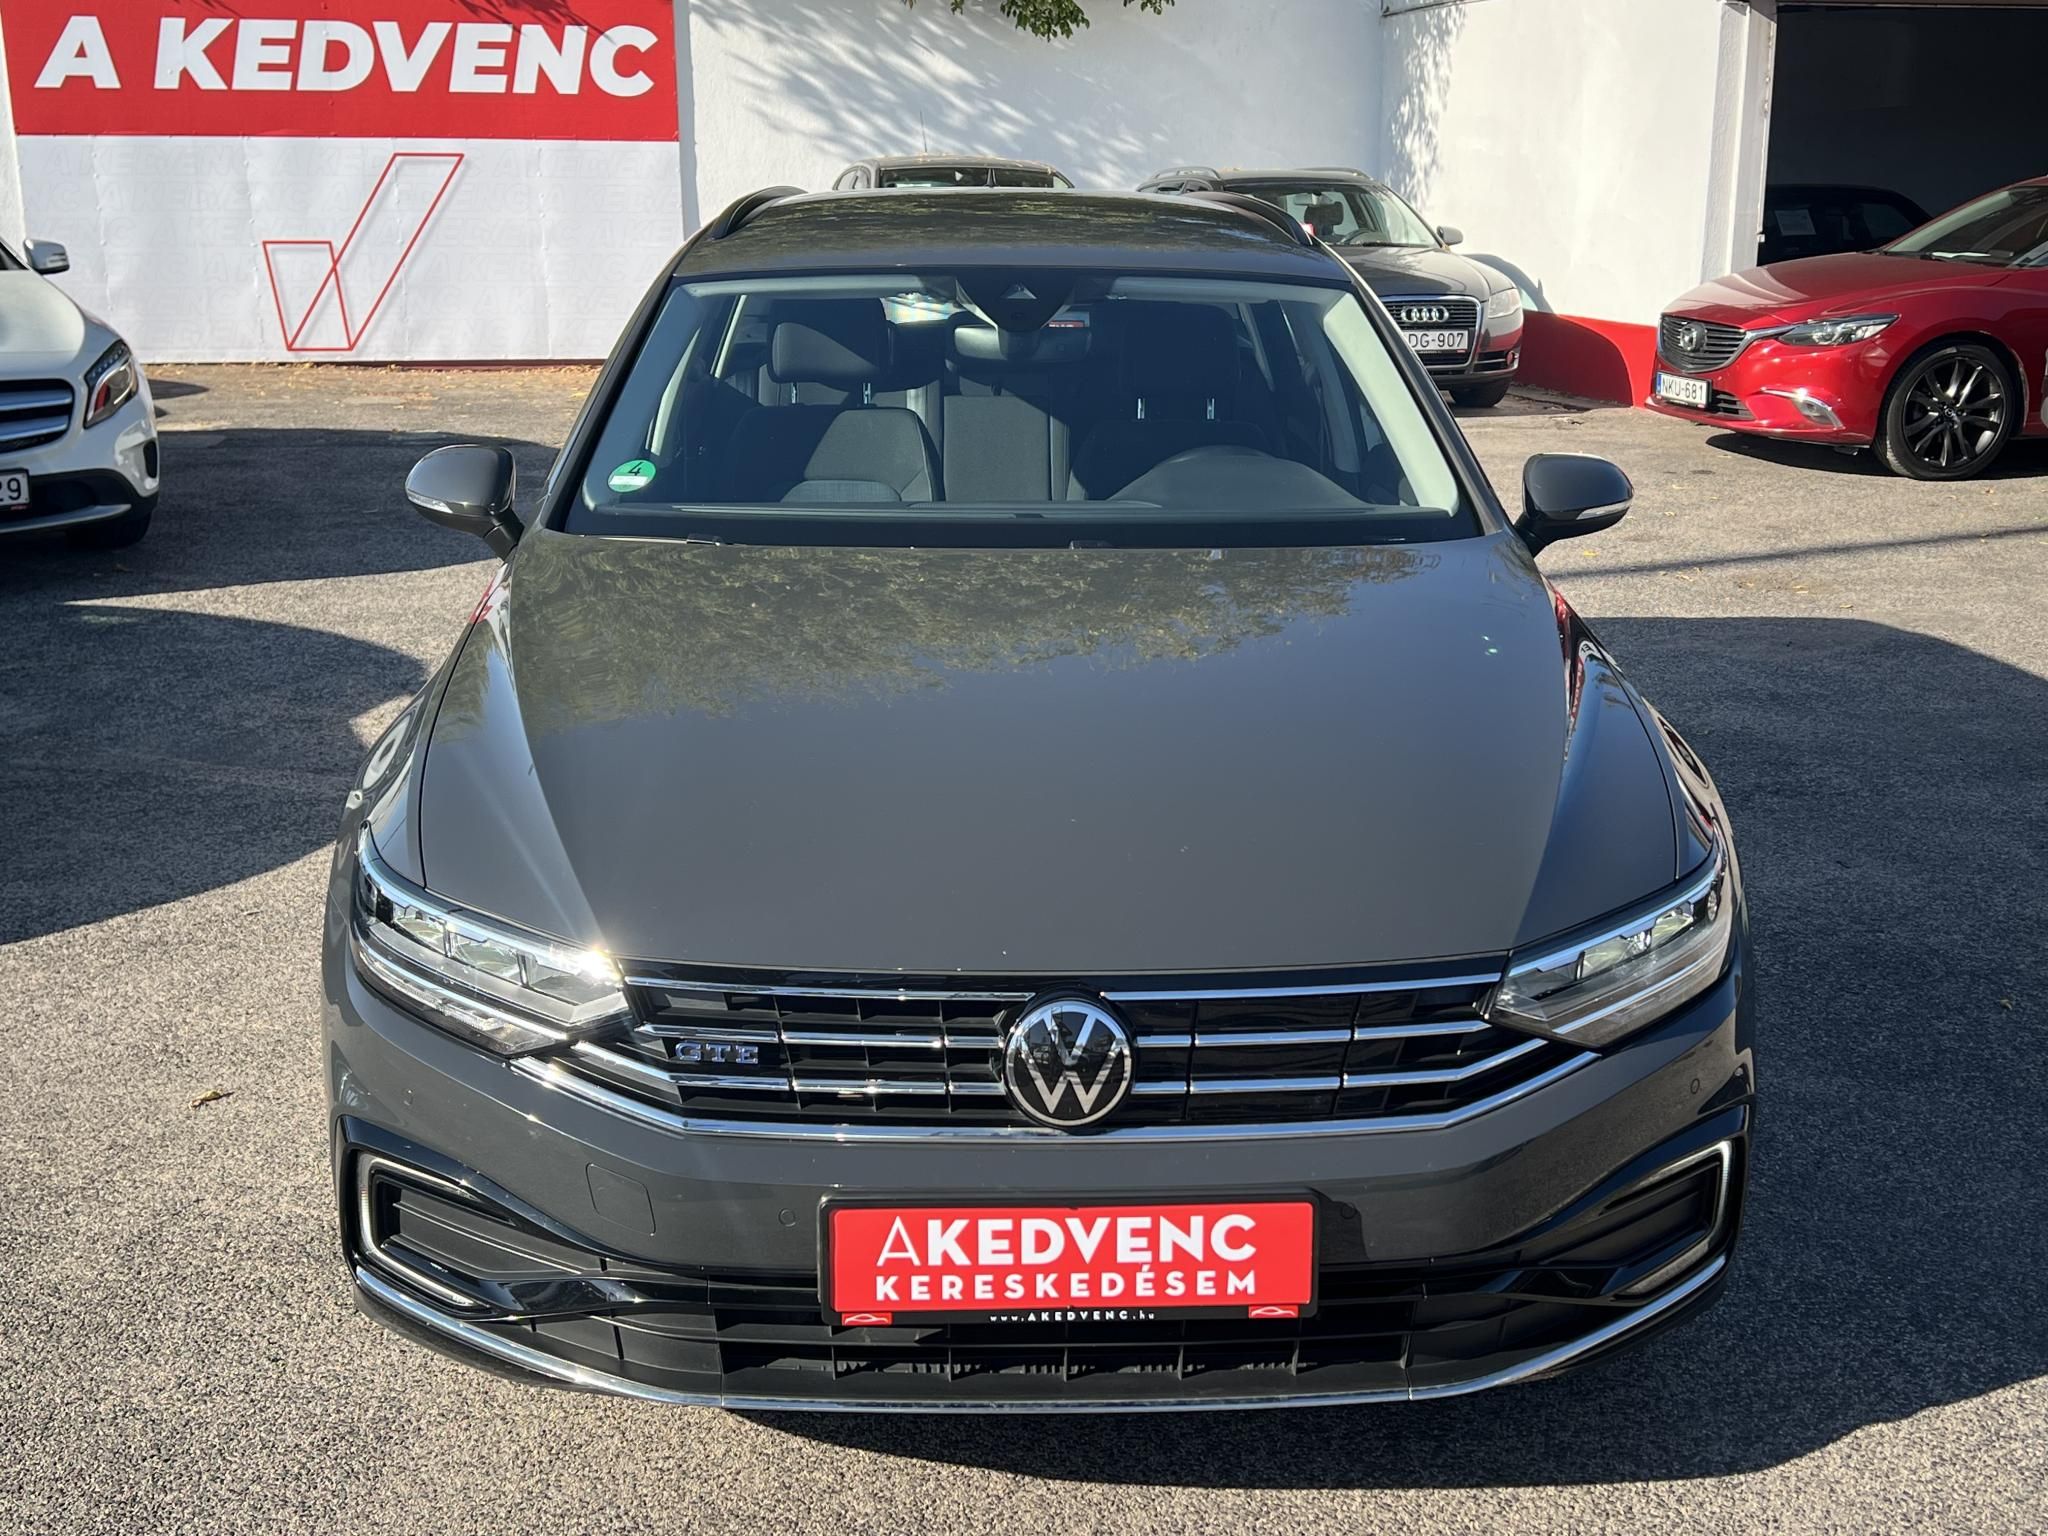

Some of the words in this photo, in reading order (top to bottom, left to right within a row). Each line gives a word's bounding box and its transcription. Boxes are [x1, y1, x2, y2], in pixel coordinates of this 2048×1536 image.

[35, 15, 121, 89] A
[154, 16, 659, 97] KEDVENC
[1662, 378, 1703, 400] NKU-681
[628, 461, 643, 476] 4
[675, 1042, 759, 1064] GTE
[875, 1263, 1256, 1302] KERESKEDÉSEM
[989, 1309, 1155, 1322] www.AKEDVENC.hu
